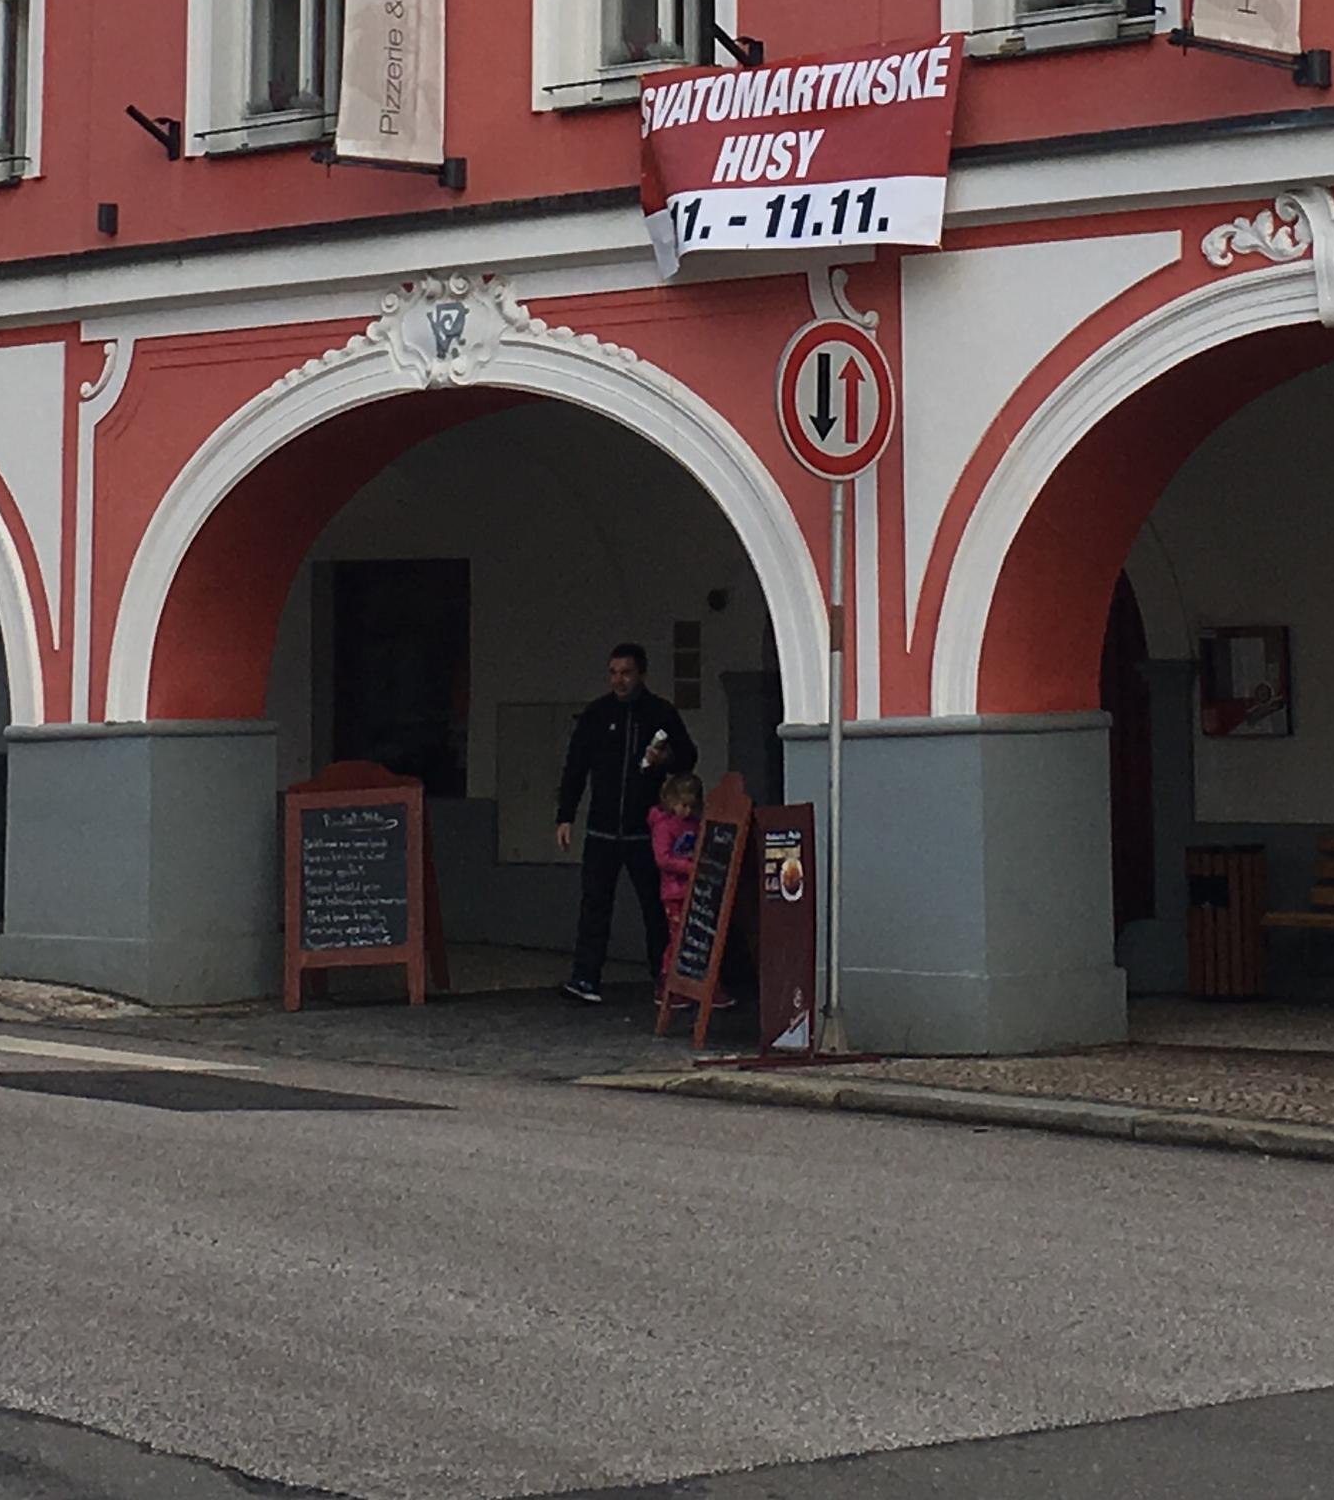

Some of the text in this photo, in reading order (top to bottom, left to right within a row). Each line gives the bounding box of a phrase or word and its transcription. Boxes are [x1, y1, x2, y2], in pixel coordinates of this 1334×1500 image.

[379, 29, 405, 136] Pizzerie
[641, 35, 952, 139] SVATOMARTINSKÉ
[712, 128, 825, 183] HUSY
[765, 186, 890, 239] 11.11.
